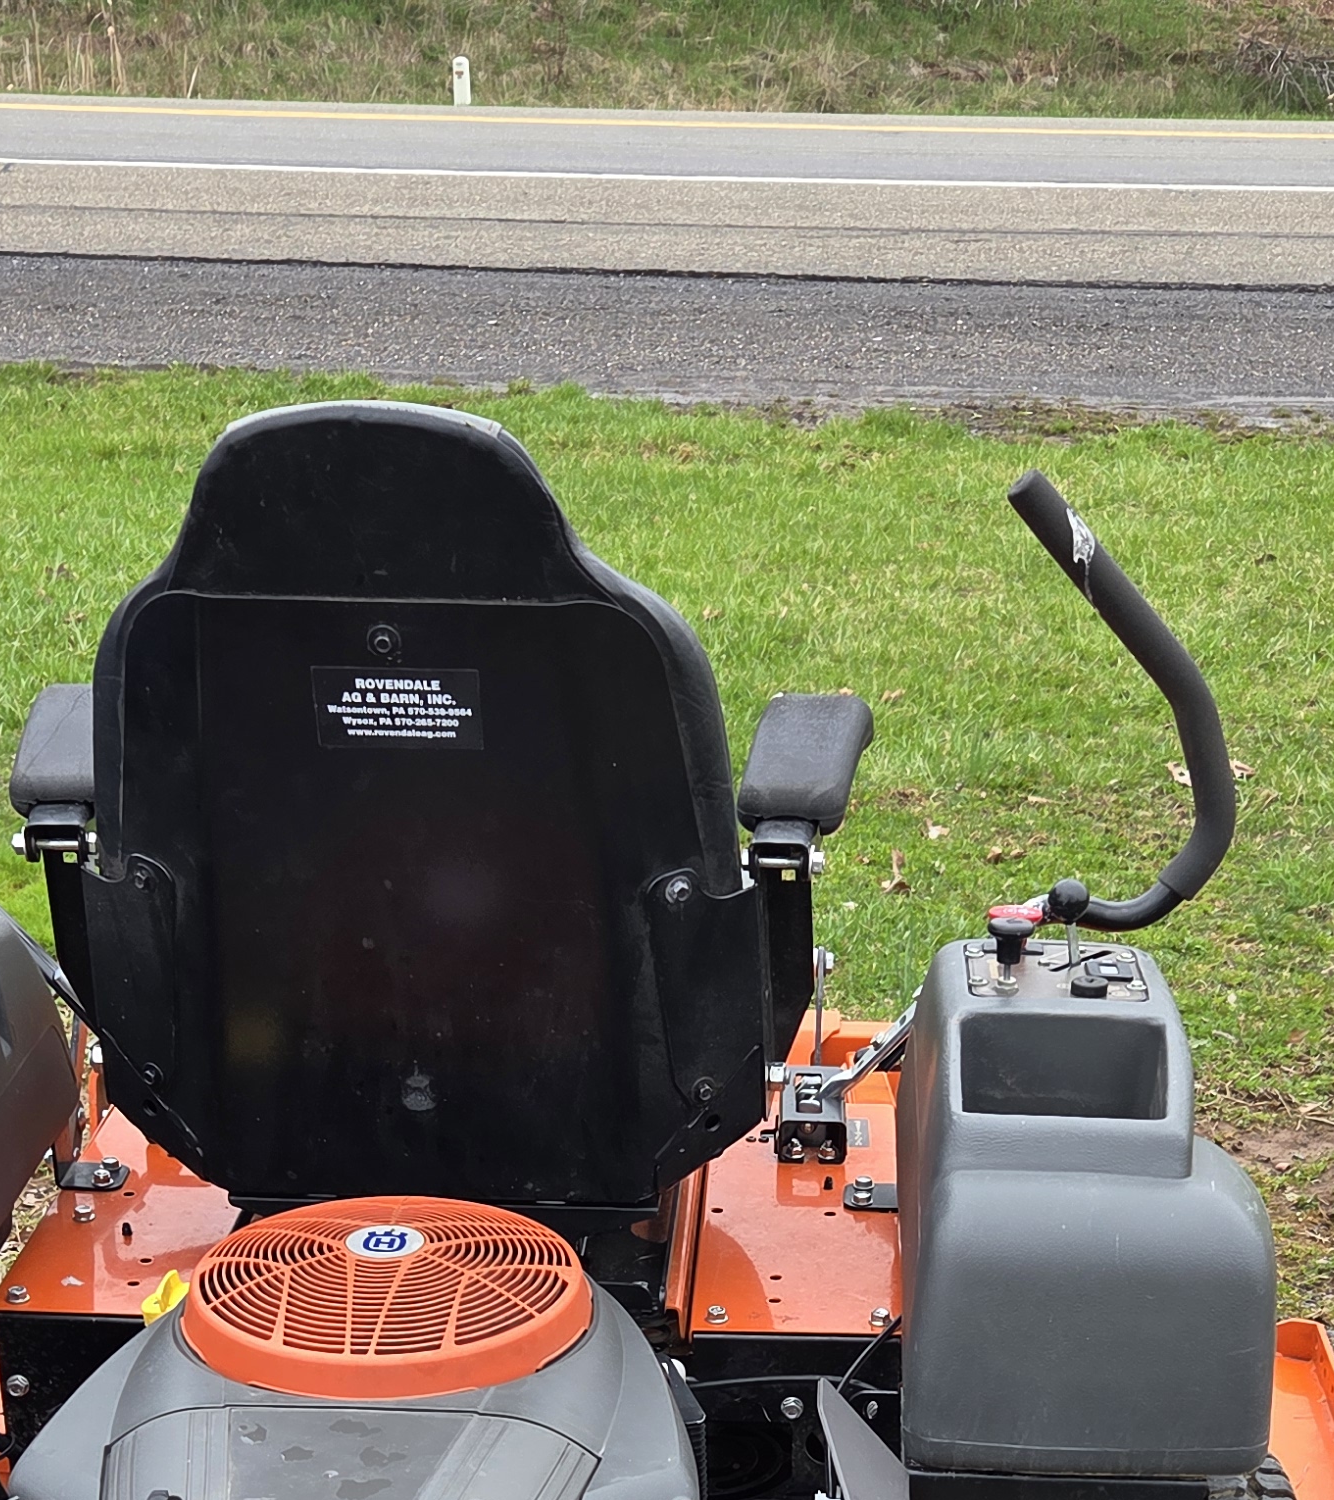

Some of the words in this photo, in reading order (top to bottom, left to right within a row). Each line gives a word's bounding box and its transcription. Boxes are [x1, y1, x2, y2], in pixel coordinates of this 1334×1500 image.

[355, 678, 441, 691] ROVENDALE
[365, 693, 377, 703] &
[380, 693, 424, 706] BARN,
[427, 694, 457, 706] INC.
[392, 707, 406, 715] PA
[379, 717, 393, 726] PA
